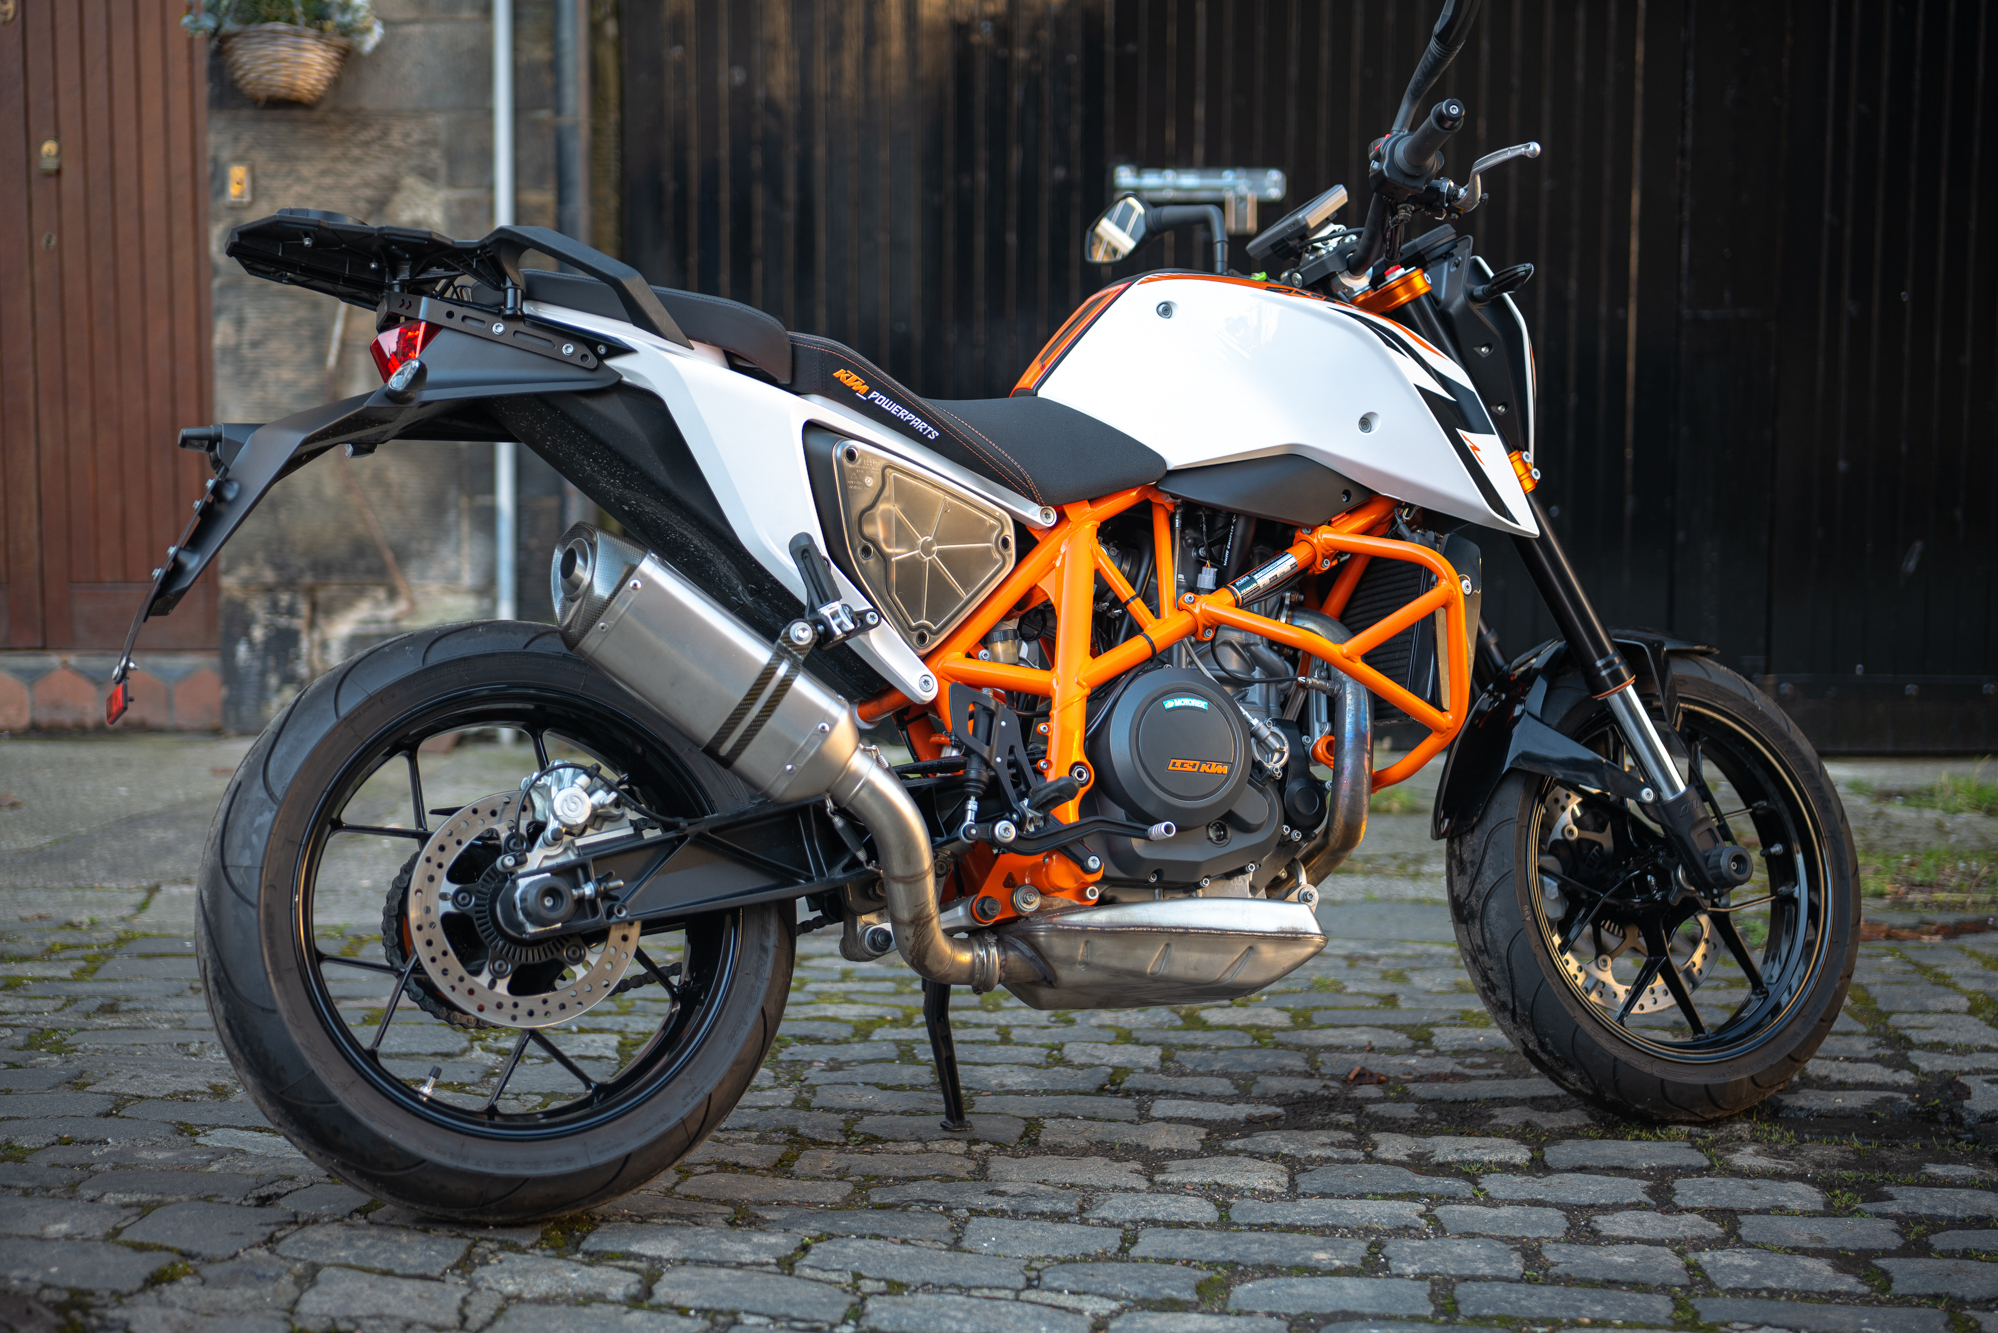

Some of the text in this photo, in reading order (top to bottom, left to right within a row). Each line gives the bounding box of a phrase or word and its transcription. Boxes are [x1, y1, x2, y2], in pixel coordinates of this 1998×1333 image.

[832, 368, 870, 395] KTM
[1173, 698, 1206, 708] MOTOREX
[1199, 761, 1229, 775] KTM
